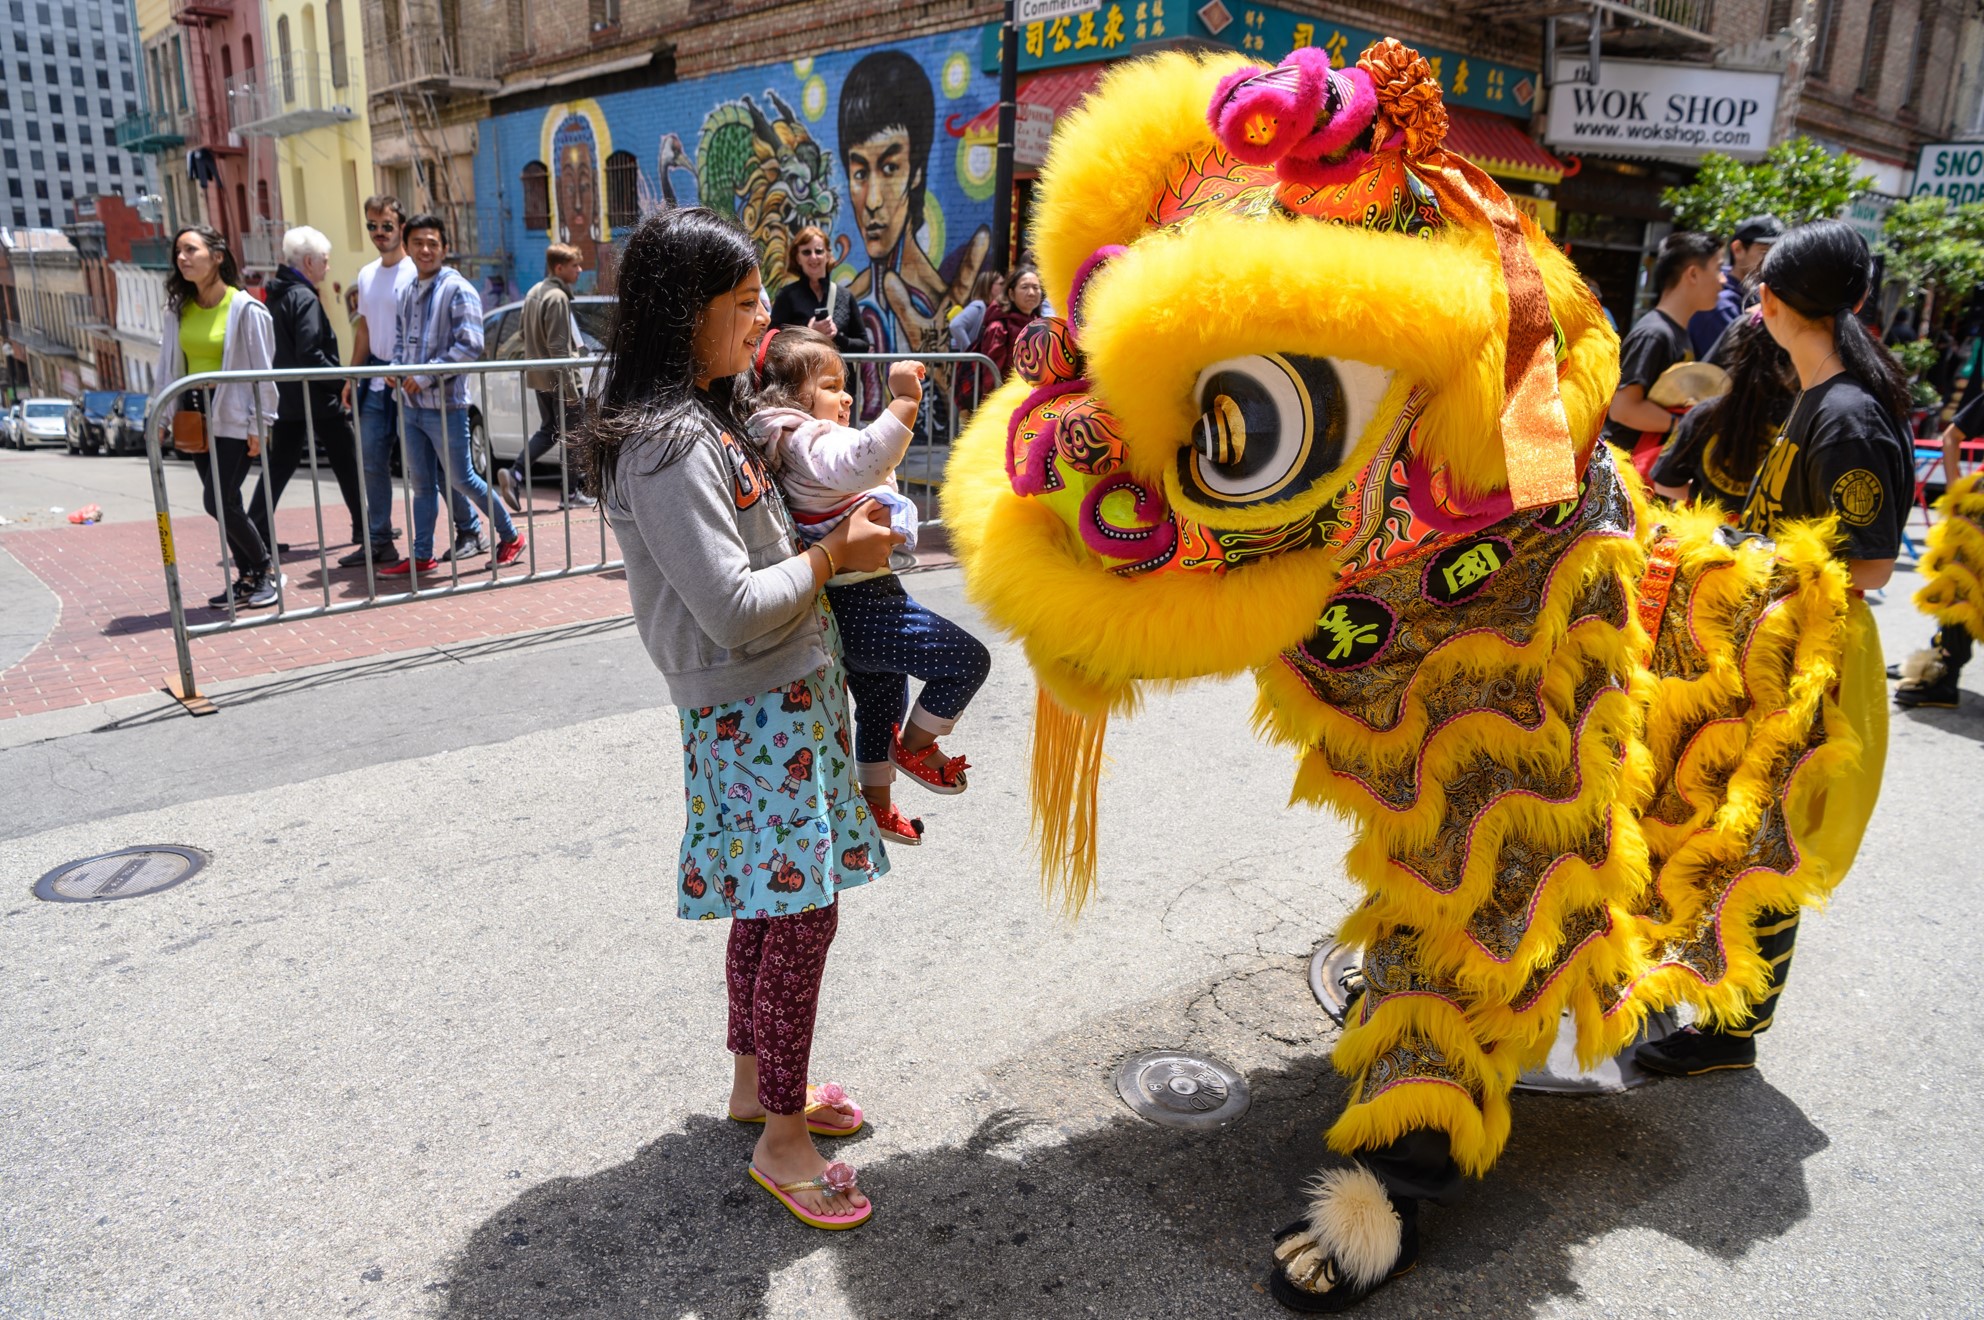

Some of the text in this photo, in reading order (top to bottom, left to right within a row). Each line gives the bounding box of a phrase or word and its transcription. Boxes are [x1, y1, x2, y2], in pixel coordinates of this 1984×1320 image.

[1573, 88, 1759, 128] WOK SHOP
[1574, 121, 1751, 146] www.wokshop.com
